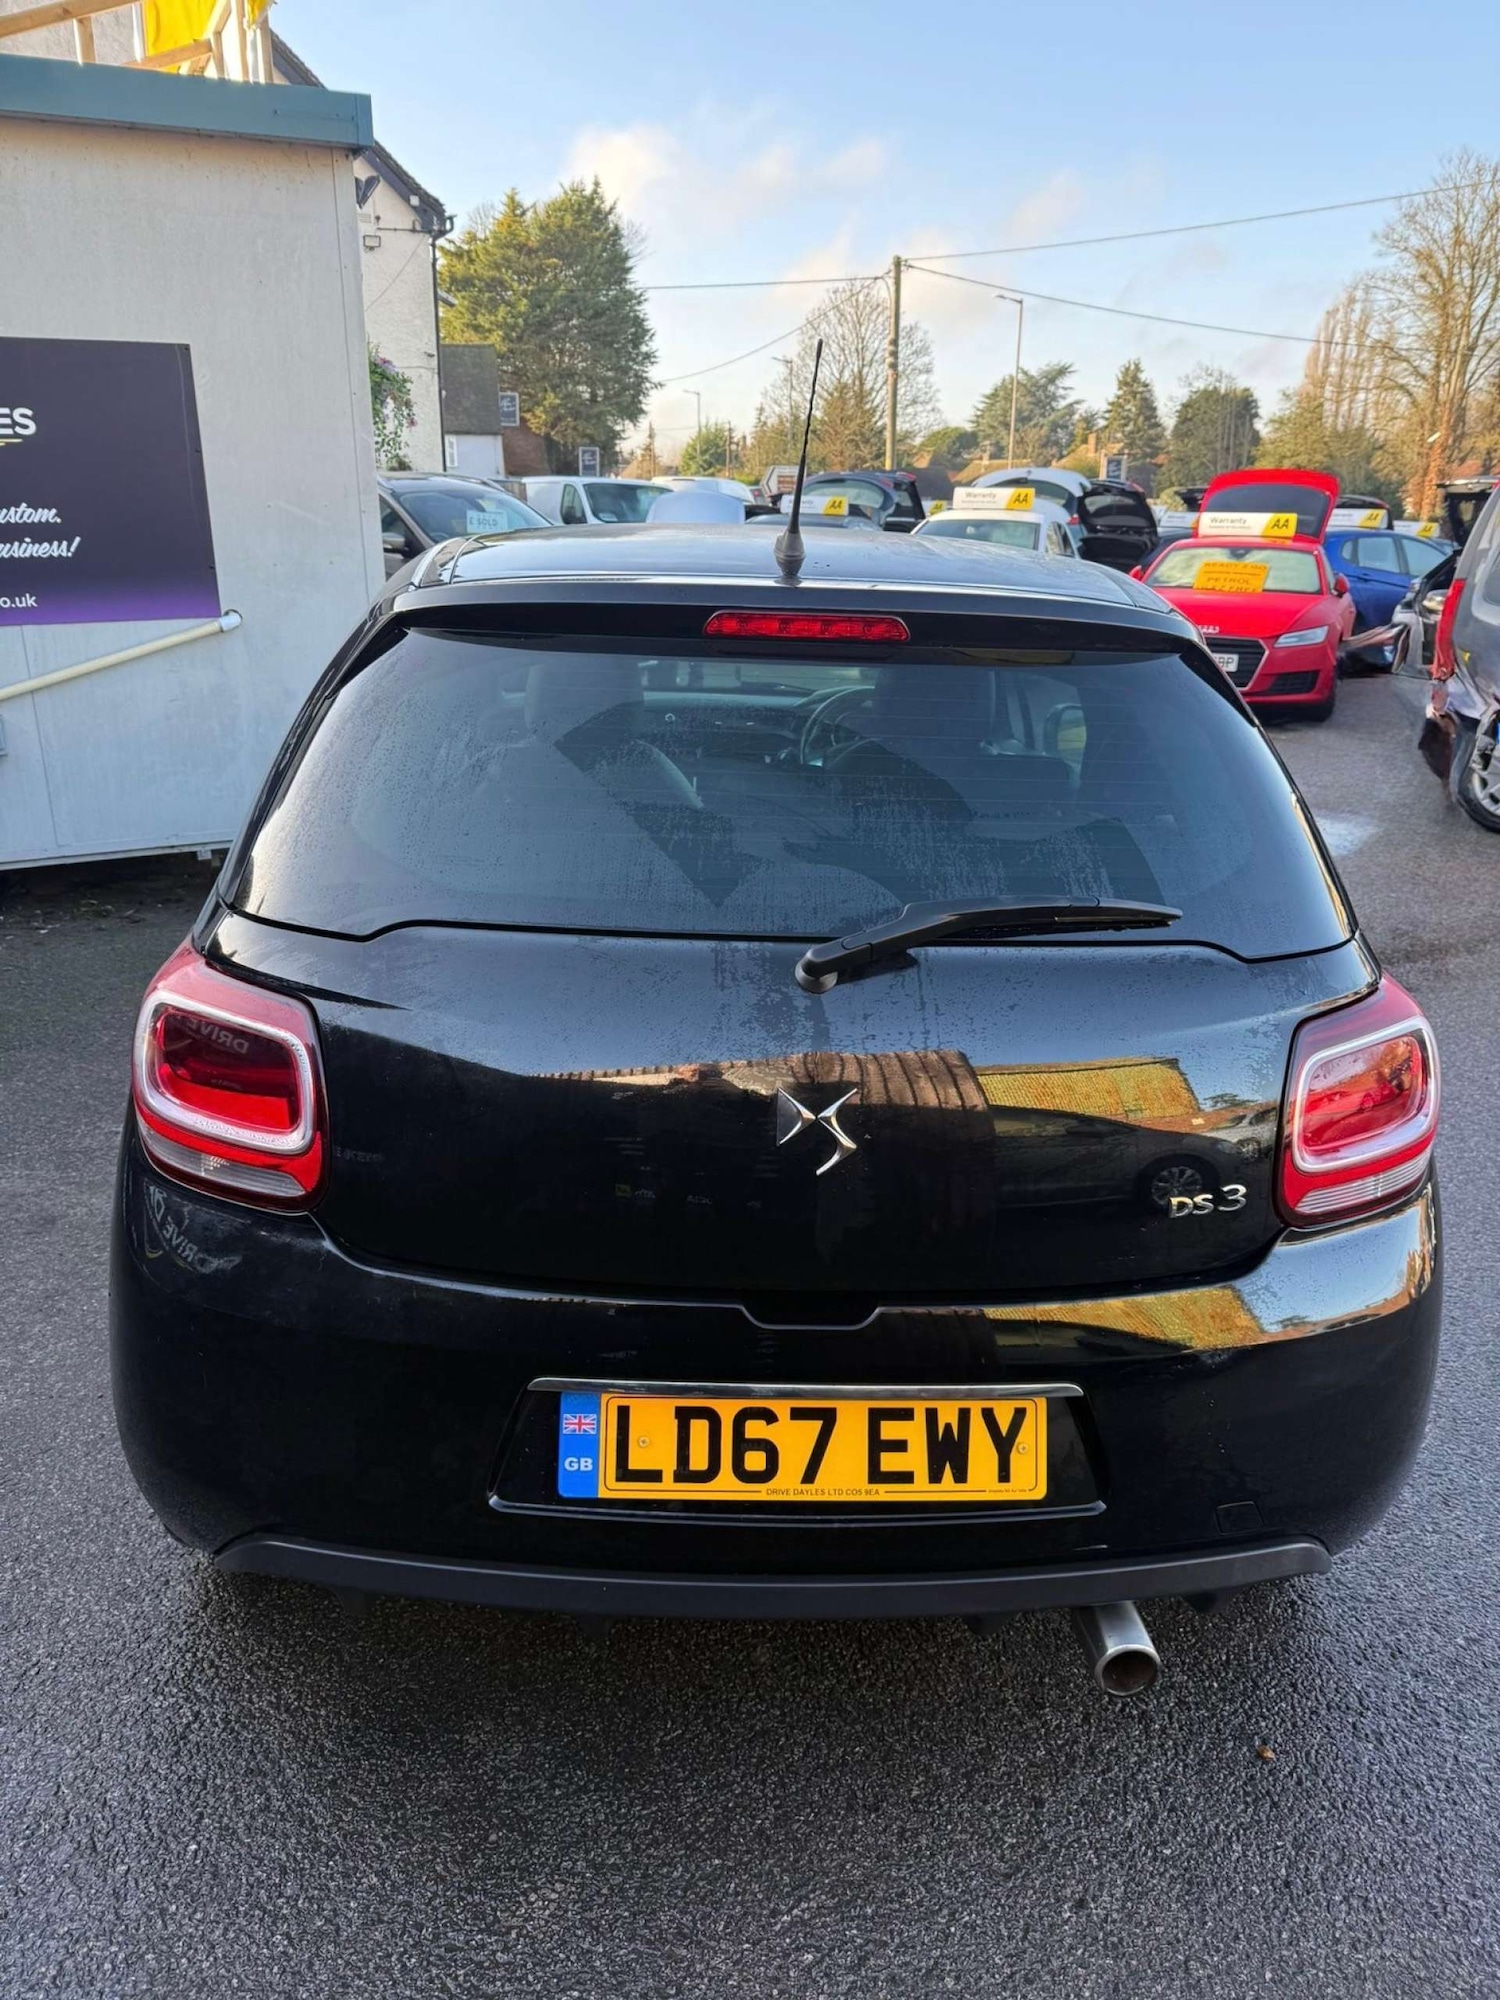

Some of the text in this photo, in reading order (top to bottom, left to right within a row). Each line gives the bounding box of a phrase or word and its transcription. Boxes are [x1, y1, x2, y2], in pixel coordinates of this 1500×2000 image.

[1012, 492, 1028, 504] AA
[1210, 516, 1289, 529] Warranty AA
[1207, 576, 1251, 585] PETROL
[1169, 1183, 1248, 1218] DS 3
[614, 1404, 1028, 1485] LD67 EWY
[564, 1457, 593, 1472] GB
[766, 1488, 791, 1497] DRIVE
[793, 1488, 825, 1497] DAYLES
[827, 1488, 844, 1497] LTD
